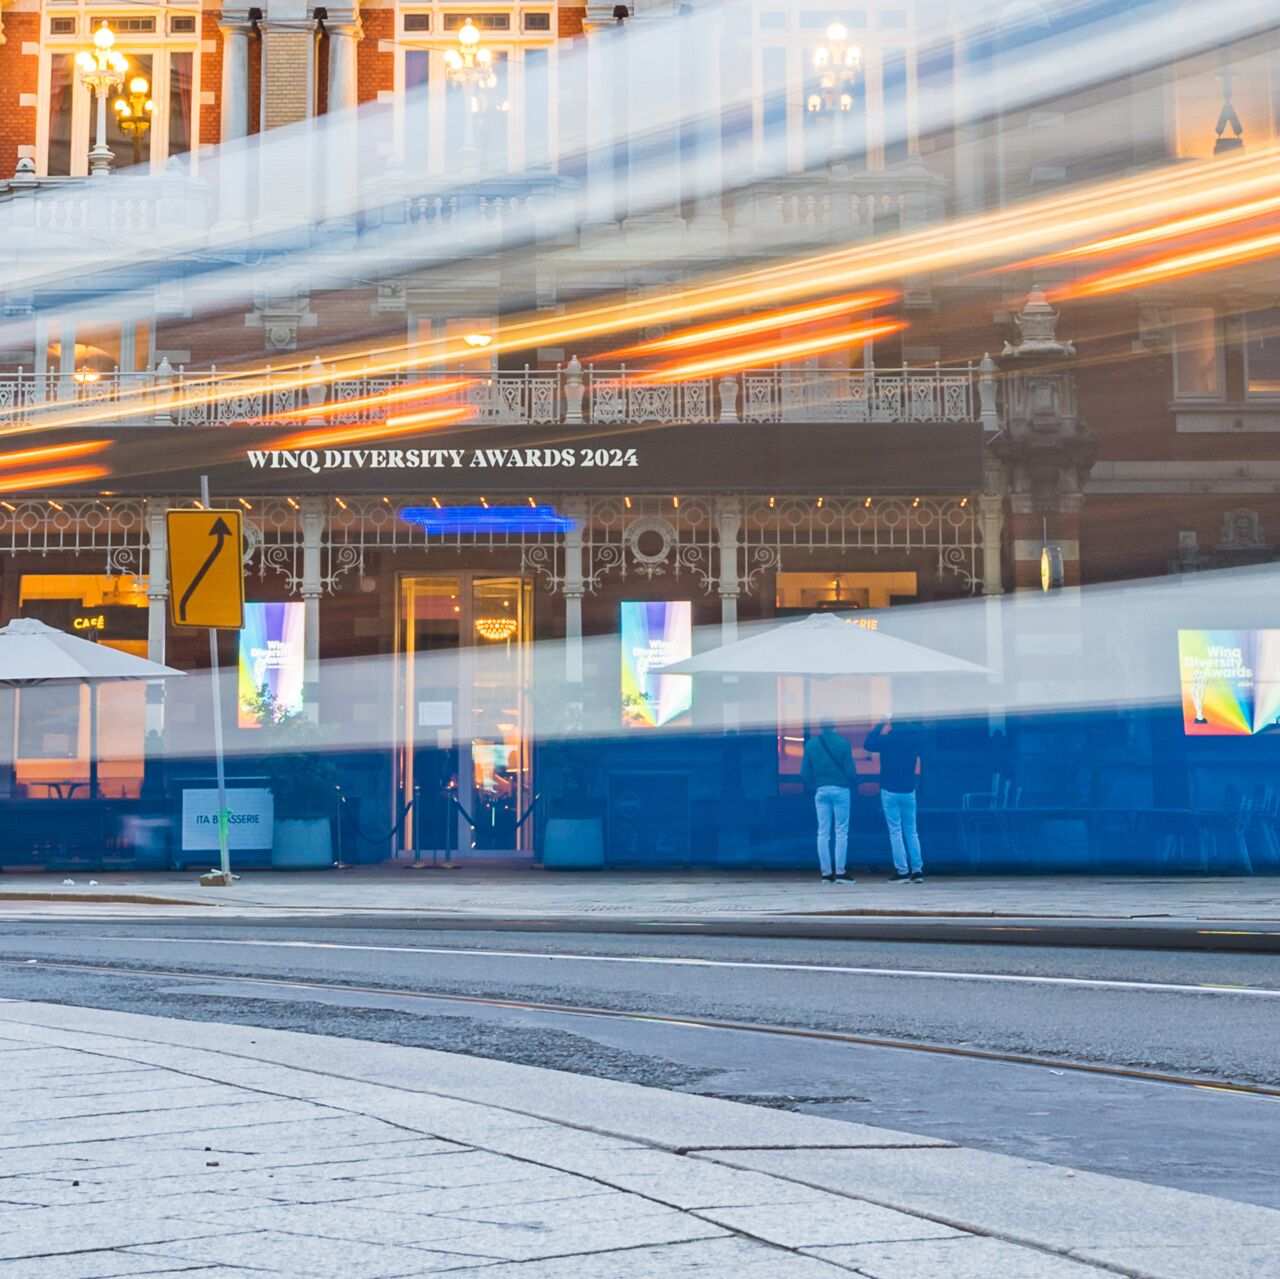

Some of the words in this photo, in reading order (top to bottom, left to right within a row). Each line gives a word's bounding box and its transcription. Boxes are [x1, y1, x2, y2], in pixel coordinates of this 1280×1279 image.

[246, 449, 321, 474] WINQ
[322, 449, 465, 468] DIVERSITY
[469, 449, 575, 468] AWARDS
[579, 448, 639, 468] 2024
[73, 615, 105, 629] CAFÉ
[1183, 655, 1244, 669] Diversity
[1204, 665, 1253, 679] Awards
[196, 815, 210, 824] ITA
[212, 814, 260, 825] BASSERIE
